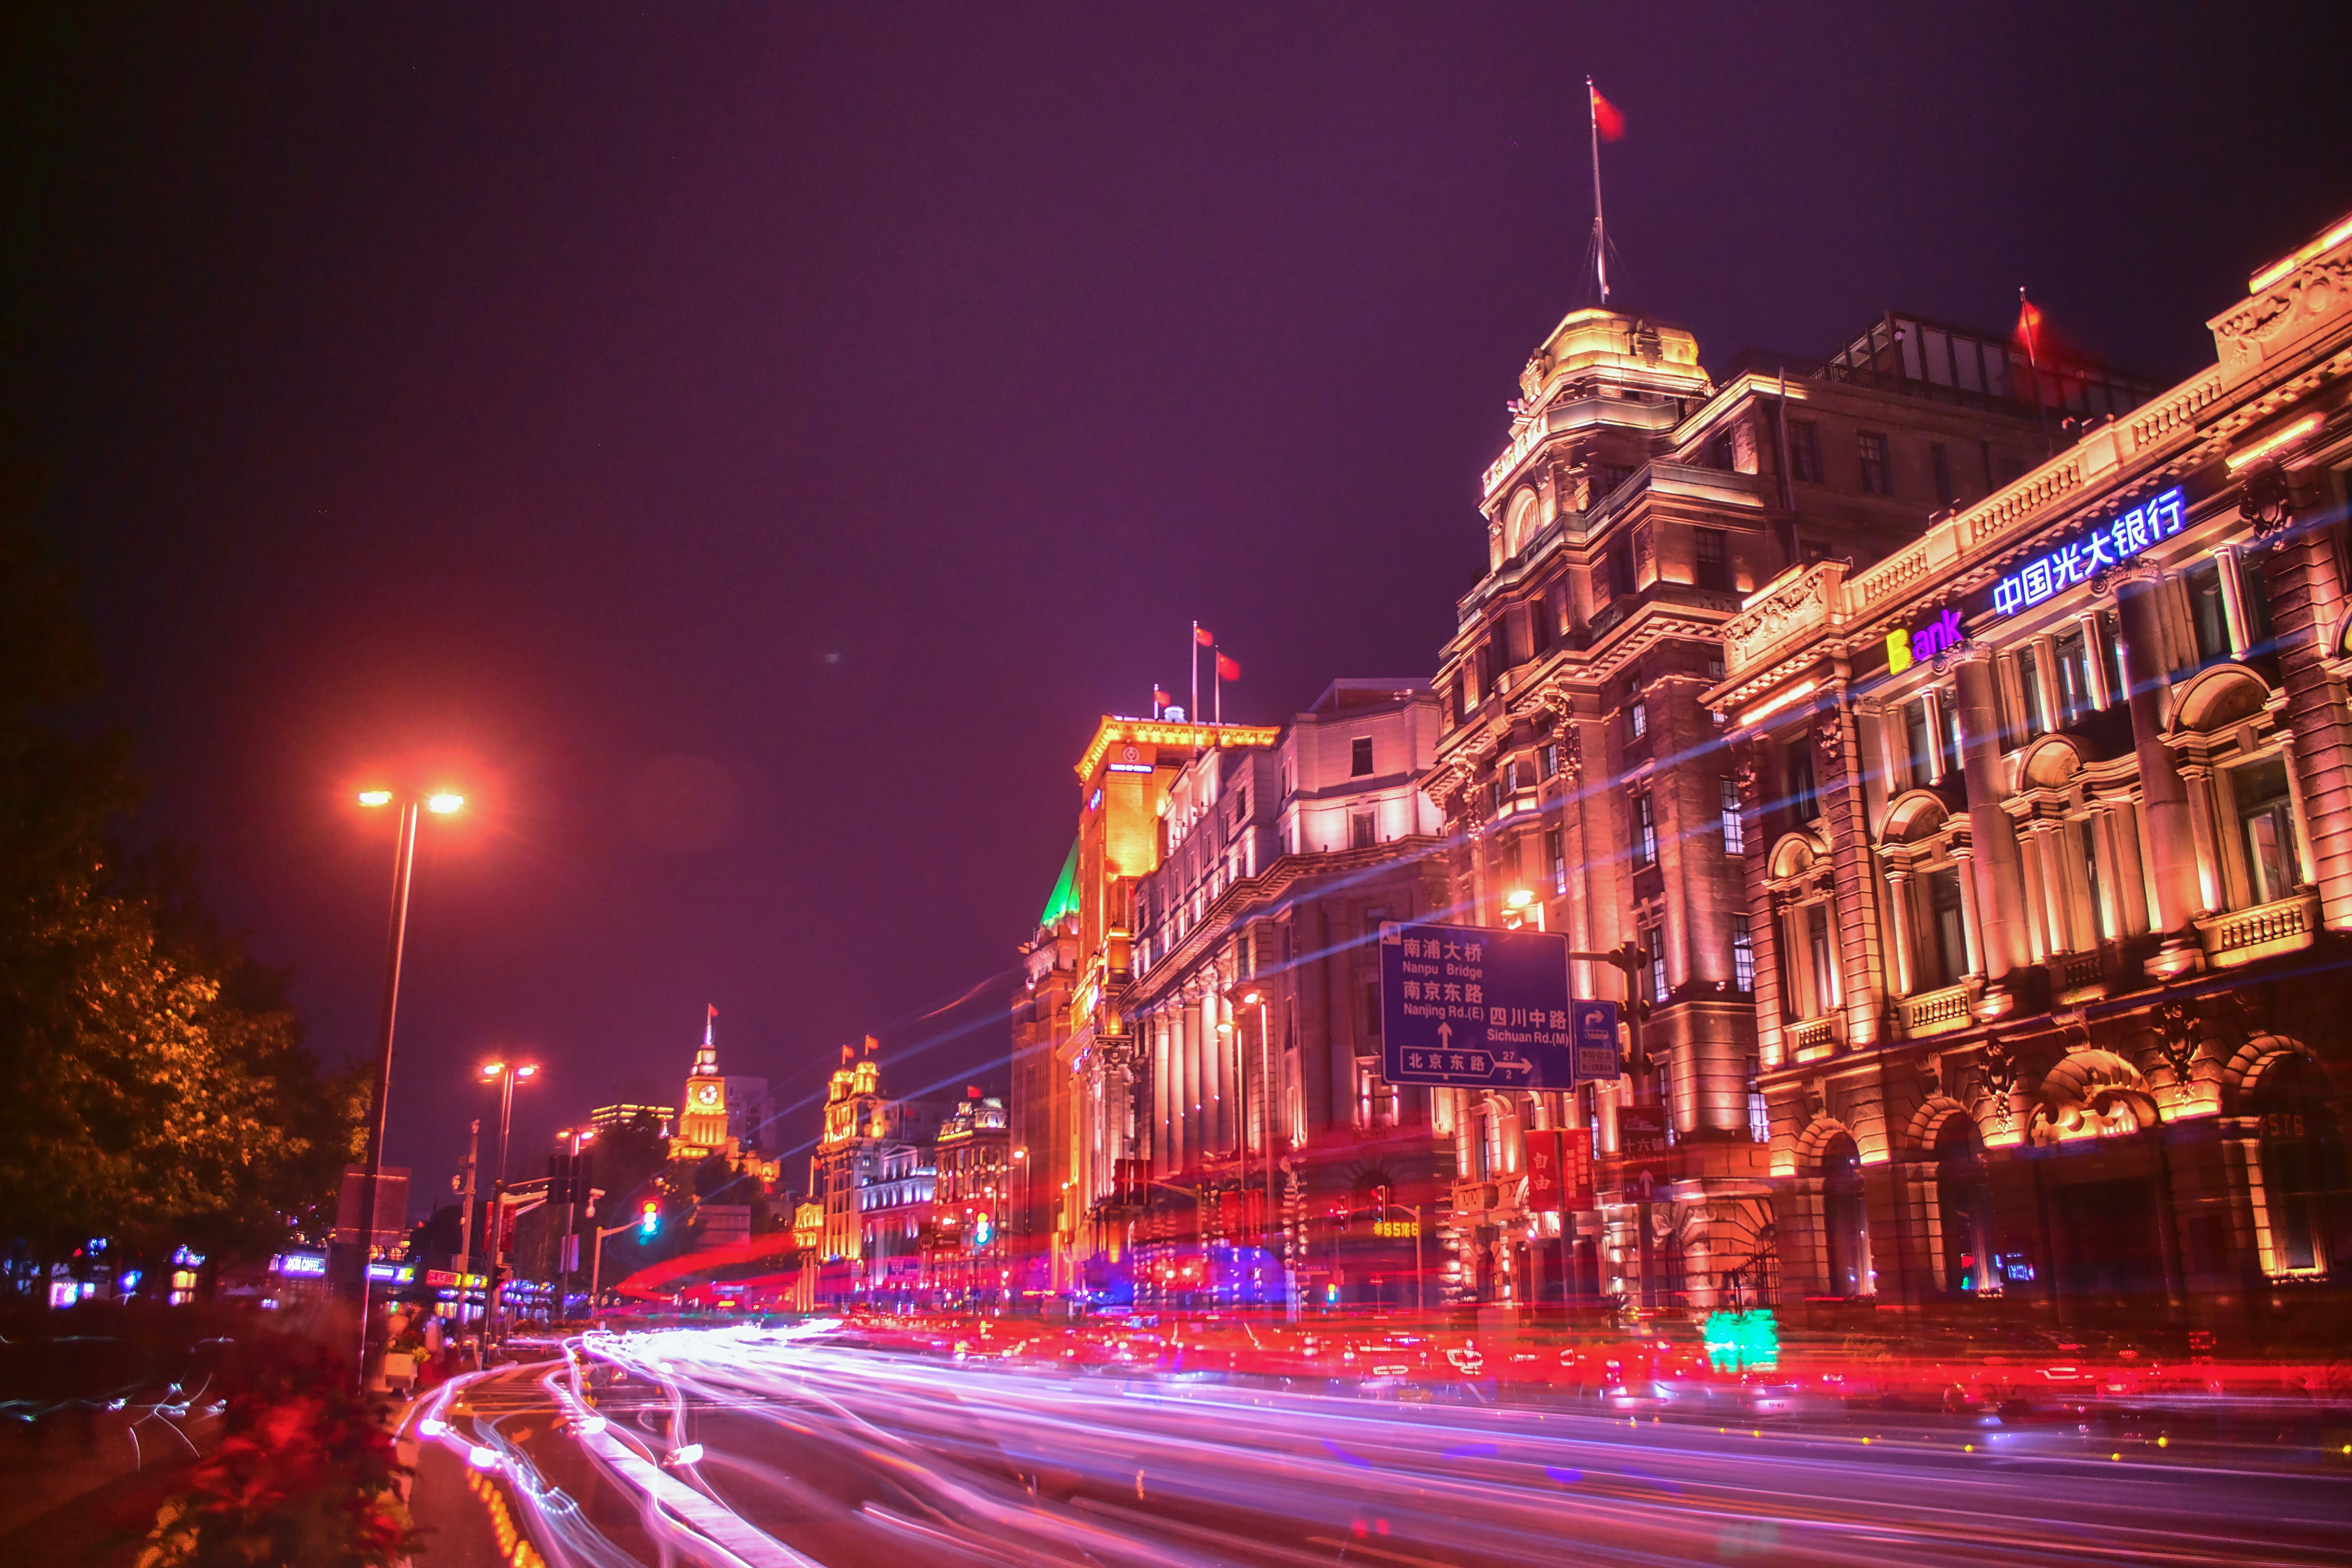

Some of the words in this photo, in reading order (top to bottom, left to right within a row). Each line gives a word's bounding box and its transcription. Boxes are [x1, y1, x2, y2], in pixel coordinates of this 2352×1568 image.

[1994, 489, 2180, 615] 中国光大银行
[1886, 609, 1963, 675] Bank
[1403, 937, 1482, 962] 南浦大桥
[1403, 960, 1438, 976] Nanpu
[1446, 963, 1483, 980] Bridge
[1403, 980, 1483, 1004] 南京东路
[1404, 1003, 1446, 1020] Nanjing
[1448, 1005, 1484, 1022] Rd.(E)
[1490, 1007, 1566, 1030] 四川中路
[1487, 1028, 1532, 1043] Sichuan
[1534, 1031, 1568, 1047] Rd.(M)
[1409, 1052, 1485, 1071] 北京东路
[1503, 1051, 1515, 1061] 27
[1505, 1069, 1512, 1079] 2
[1533, 1152, 1551, 1191] 自由
